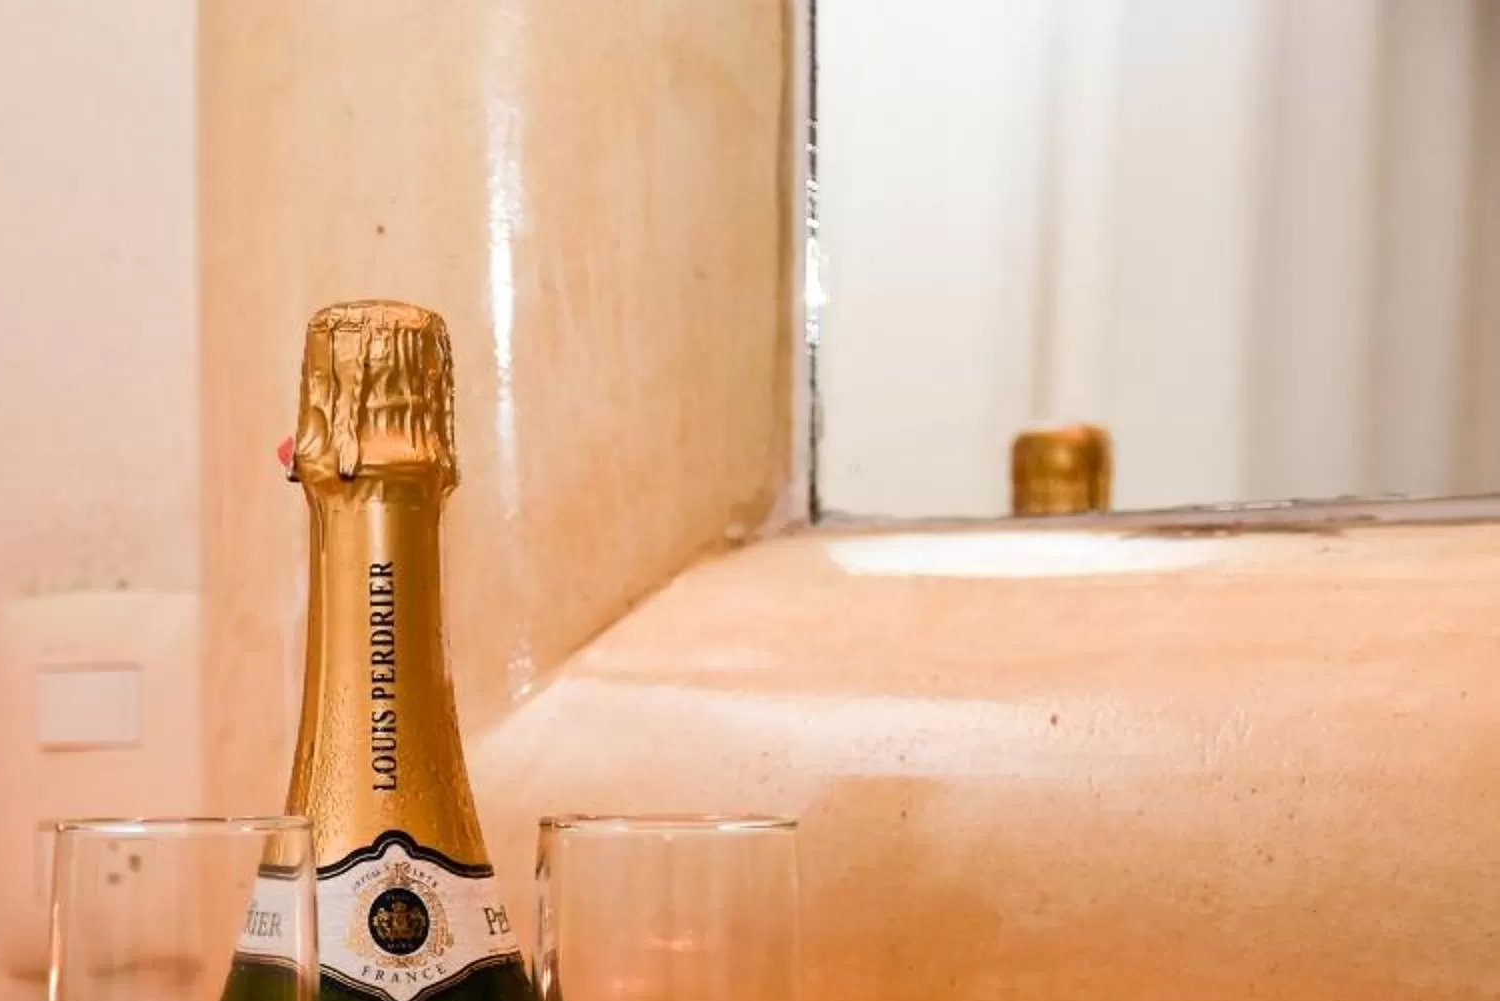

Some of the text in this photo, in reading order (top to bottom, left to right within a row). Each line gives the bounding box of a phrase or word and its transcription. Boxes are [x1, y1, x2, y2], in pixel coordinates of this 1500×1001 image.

[369, 560, 398, 792] LOUIS PERDRIER
[361, 963, 447, 984] FRANCE
